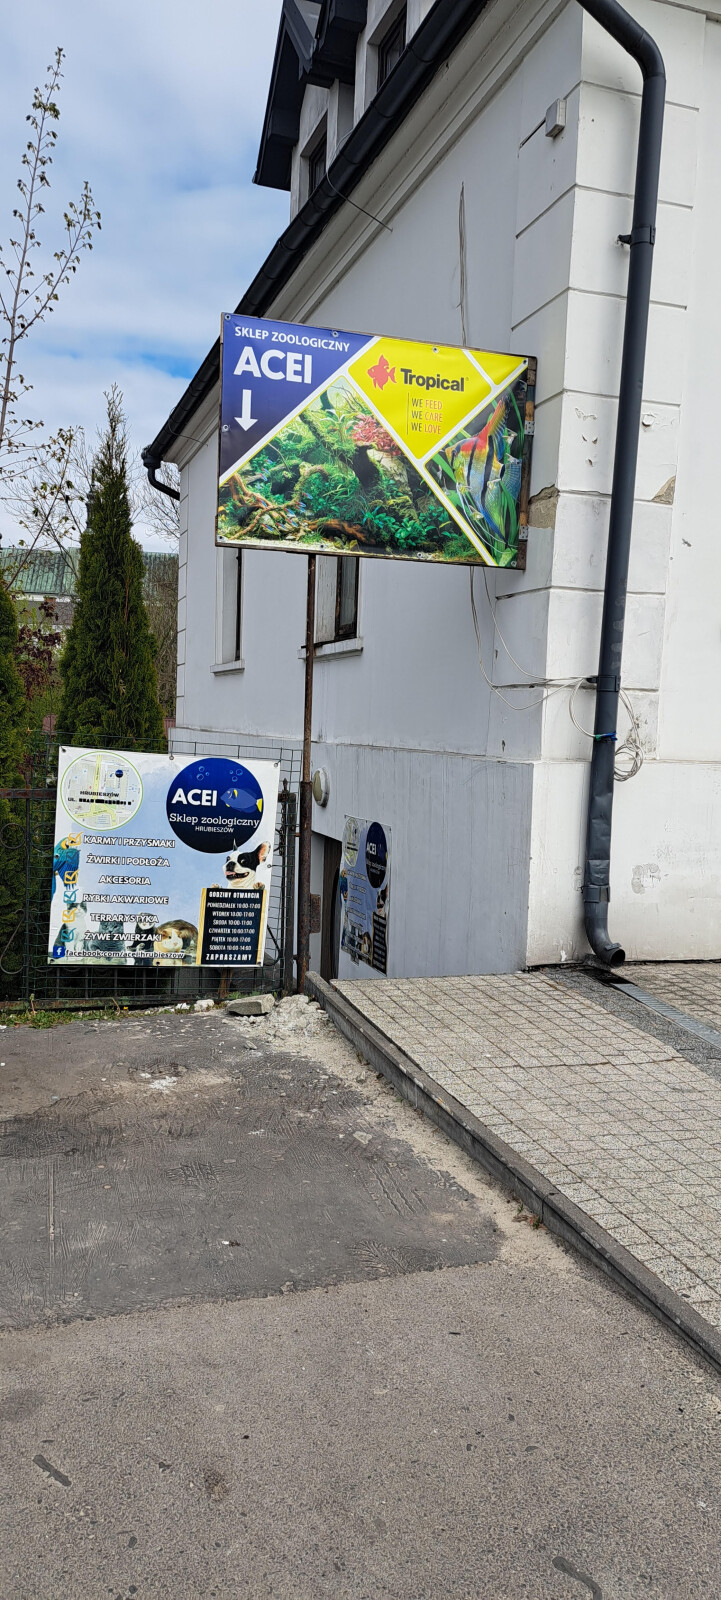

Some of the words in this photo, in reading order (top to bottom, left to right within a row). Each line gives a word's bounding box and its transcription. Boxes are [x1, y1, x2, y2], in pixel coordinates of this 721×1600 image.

[234, 326, 269, 340] SKLEP
[271, 331, 350, 352] ZOOLOGICZNY
[233, 346, 313, 384] ACEI
[400, 368, 465, 392] Tropical
[411, 398, 423, 408] WE
[425, 399, 443, 410] FEED
[411, 410, 423, 420] WE
[424, 411, 443, 423] CARE
[411, 422, 423, 433] WE
[424, 423, 442, 435] LOVE
[171, 787, 218, 806] ACEI
[169, 812, 199, 826] Sklep
[201, 815, 260, 829] zoologiczny
[195, 825, 234, 833] HRUBIESZÓW
[83, 835, 117, 846] KARMY
[123, 837, 176, 849] PRZYSMAKI
[86, 853, 121, 866] ŻWIRKI
[126, 856, 171, 868] PODŁOŻA
[98, 875, 152, 886] AKCESORIA
[82, 893, 111, 903] RYBKI
[111, 895, 169, 905] AKWARIOWE
[90, 913, 160, 924] TERRARYSTYKA
[84, 930, 111, 942] ŻYWE
[113, 933, 162, 943] ZWIERZAKI
